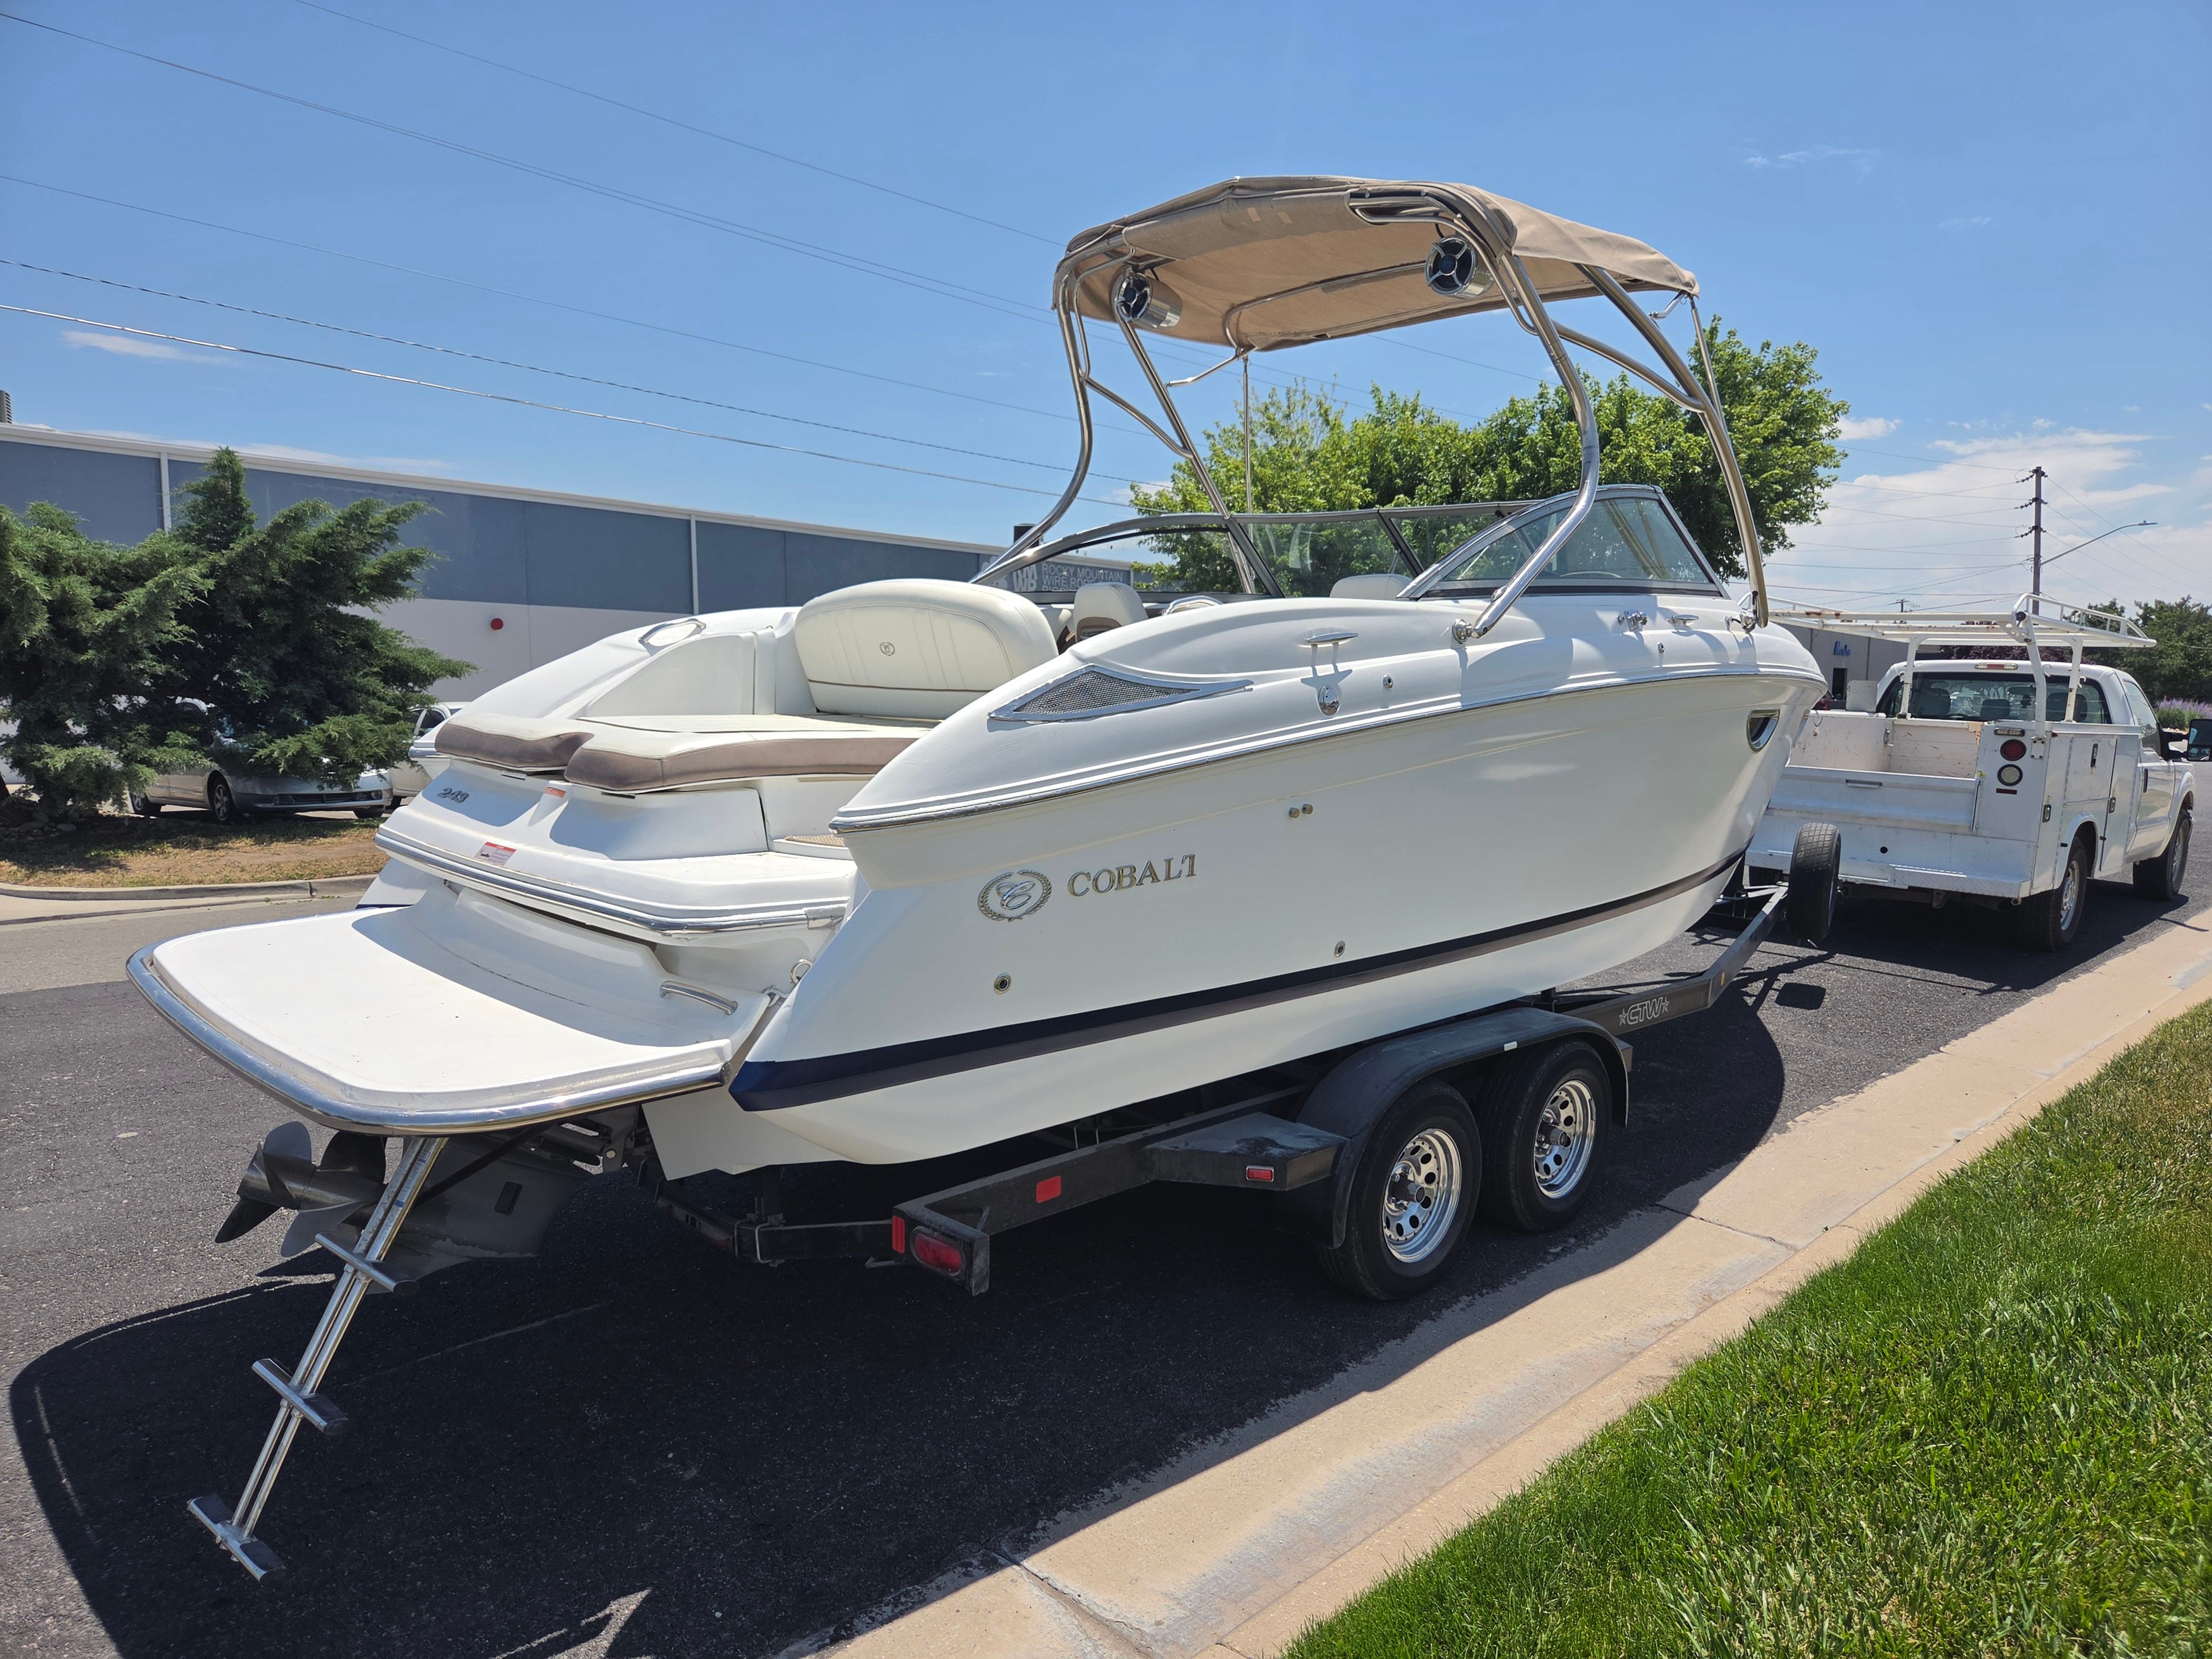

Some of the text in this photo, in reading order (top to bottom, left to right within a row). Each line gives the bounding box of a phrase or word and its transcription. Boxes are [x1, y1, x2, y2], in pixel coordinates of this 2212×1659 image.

[1042, 564, 1123, 582] ROCKY MOUNTAIN
[1043, 575, 1068, 587] WIRE
[437, 787, 469, 803] 243
[1067, 854, 1197, 896] COBALT
